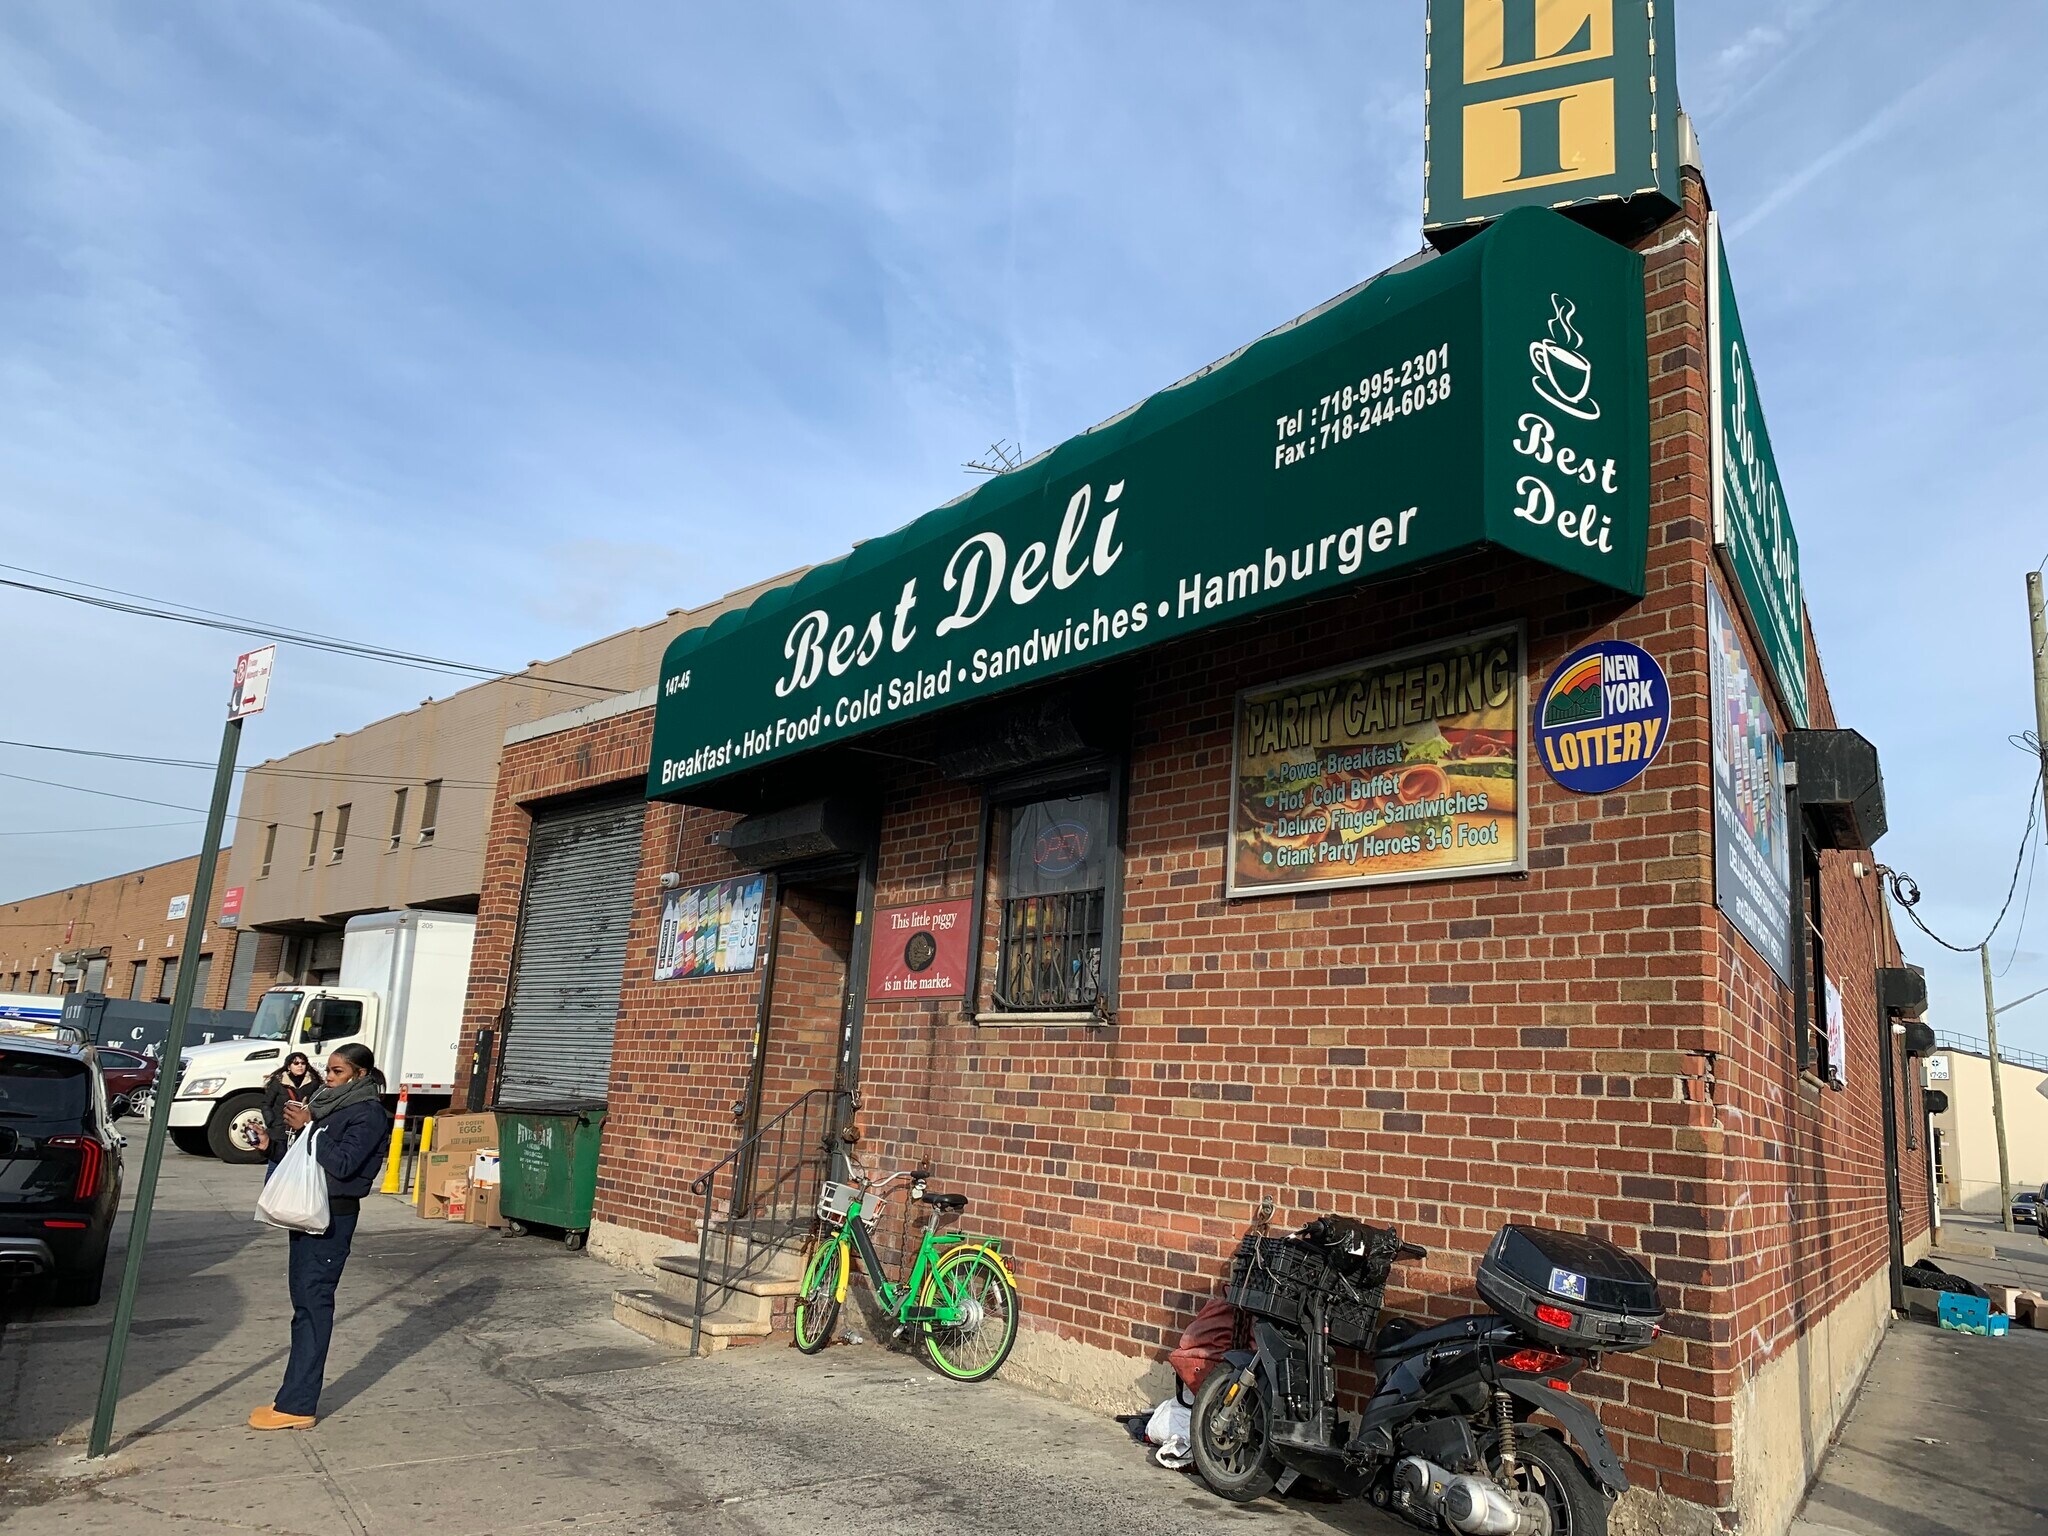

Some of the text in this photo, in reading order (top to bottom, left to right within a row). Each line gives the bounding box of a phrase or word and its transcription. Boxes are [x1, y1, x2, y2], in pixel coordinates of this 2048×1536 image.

[1276, 409, 1303, 441] Tel
[1512, 412, 1618, 494] Best
[1513, 476, 1614, 554] Deli
[774, 479, 1126, 698] Best Deli
[661, 507, 1418, 785] Breakfast Hot Food Cold Salad Sandwiches Hamburger
[1604, 654, 1639, 680] NEW
[1247, 647, 1511, 756] PARTY CATERING
[1604, 680, 1654, 715] YORK
[1279, 741, 1402, 782] Power Breakfast
[1544, 718, 1661, 772] LOTTERY
[1278, 773, 1400, 811] Hot Cold Buffet
[1278, 791, 1488, 838] Deluxe Finger Sandwiches
[1276, 819, 1498, 866] Giant Party Heroes 3-6 Foot
[741, 908, 750, 948] core
[749, 903, 759, 946] core
[891, 909, 958, 931] This little piggy
[885, 972, 952, 991] is in the market.
[459, 1125, 482, 1134] EGGS
